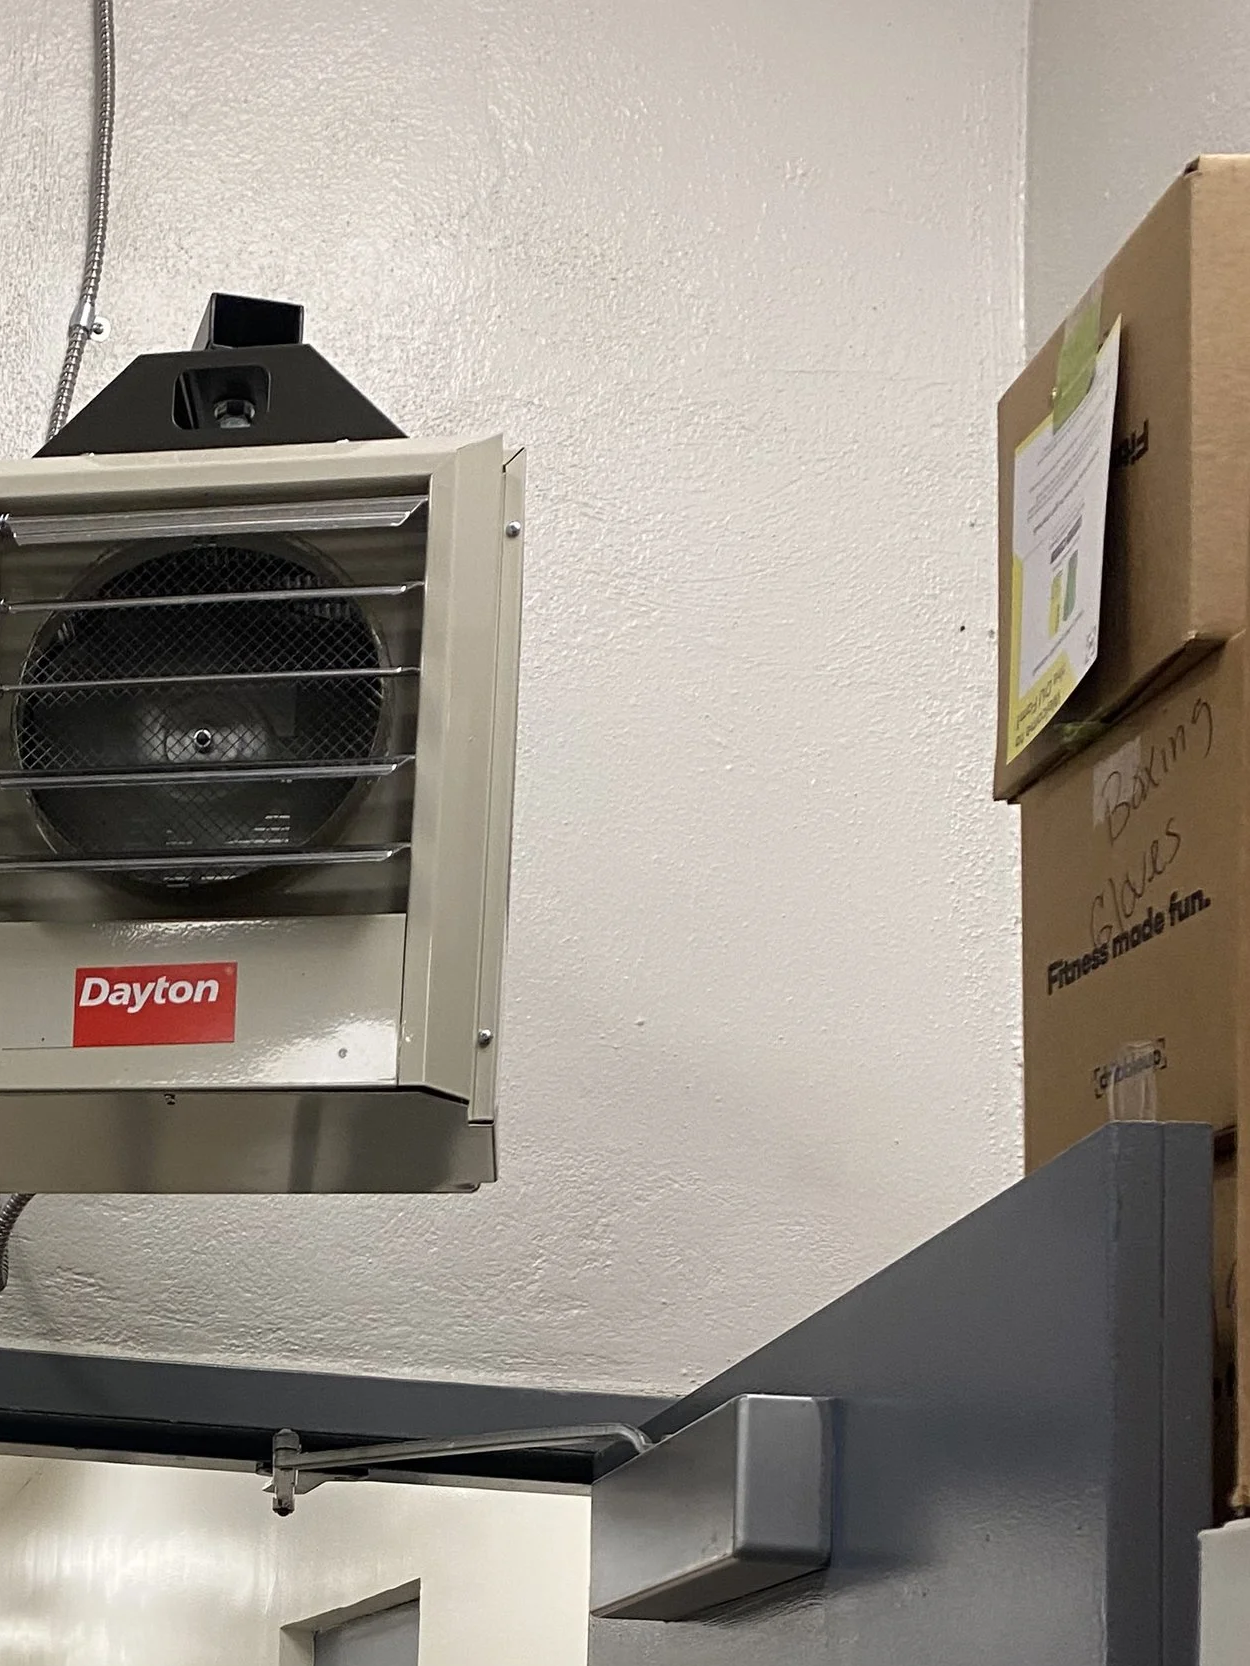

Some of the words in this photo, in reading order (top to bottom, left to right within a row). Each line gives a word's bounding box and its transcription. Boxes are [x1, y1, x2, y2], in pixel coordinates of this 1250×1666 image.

[1101, 698, 1213, 847] Boxing
[1047, 943, 1110, 997] Fitness
[1112, 906, 1166, 959] made
[1169, 889, 1212, 928] fun.
[1090, 816, 1181, 950] Gloves
[78, 975, 220, 1015] Dayton
